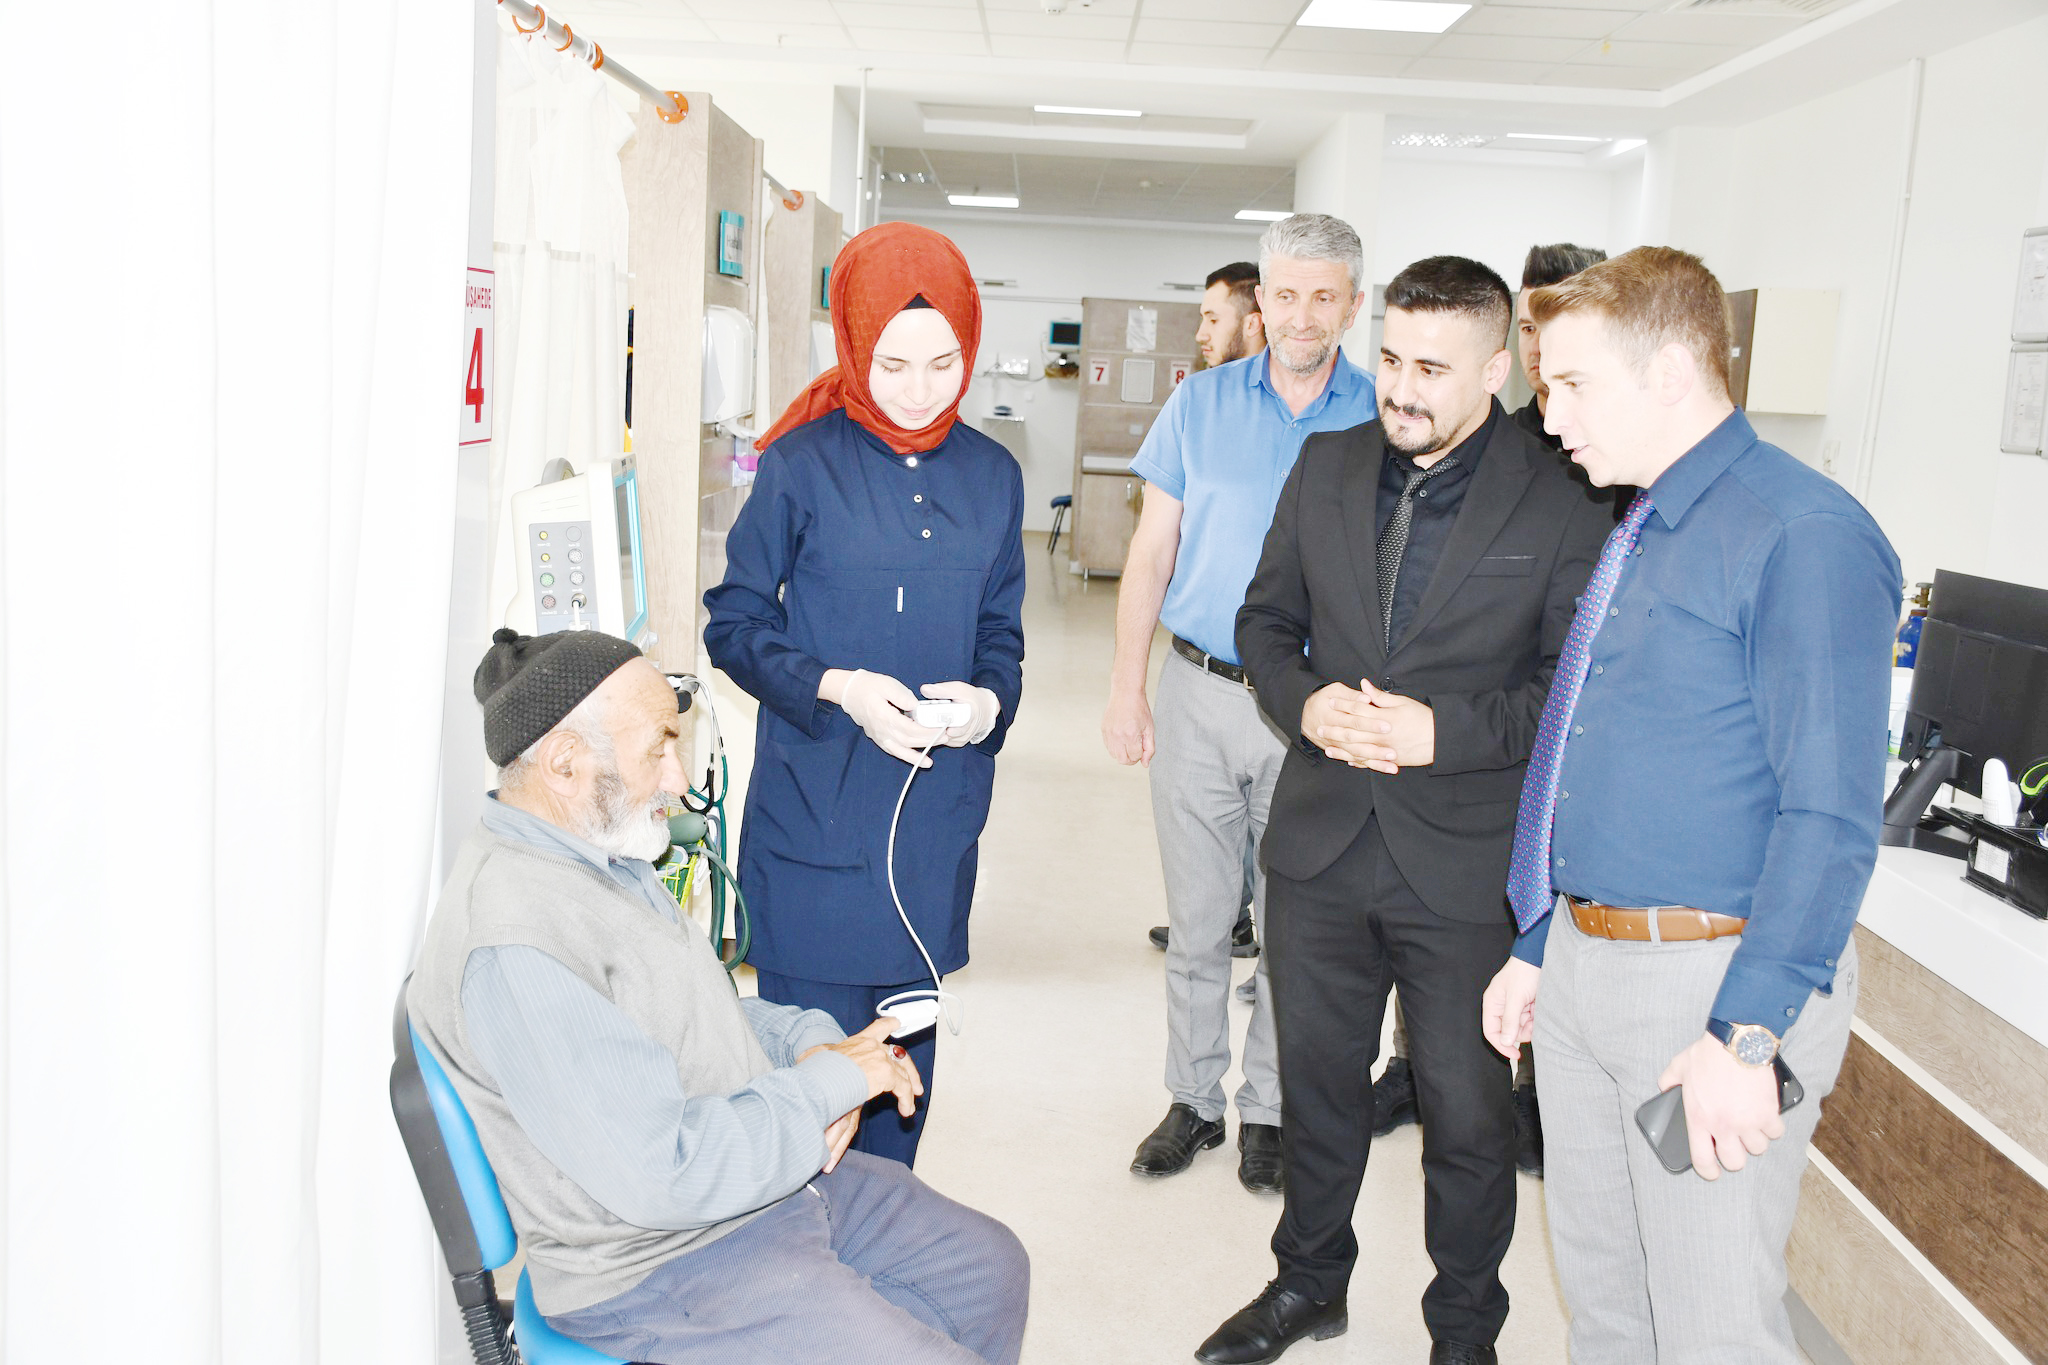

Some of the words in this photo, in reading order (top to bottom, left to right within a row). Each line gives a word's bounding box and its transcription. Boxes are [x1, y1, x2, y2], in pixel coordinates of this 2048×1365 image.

[466, 280, 491, 313] ÜŞAHEDE
[465, 327, 485, 423] 4
[1095, 366, 1105, 382] 7
[1175, 369, 1185, 385] 8
